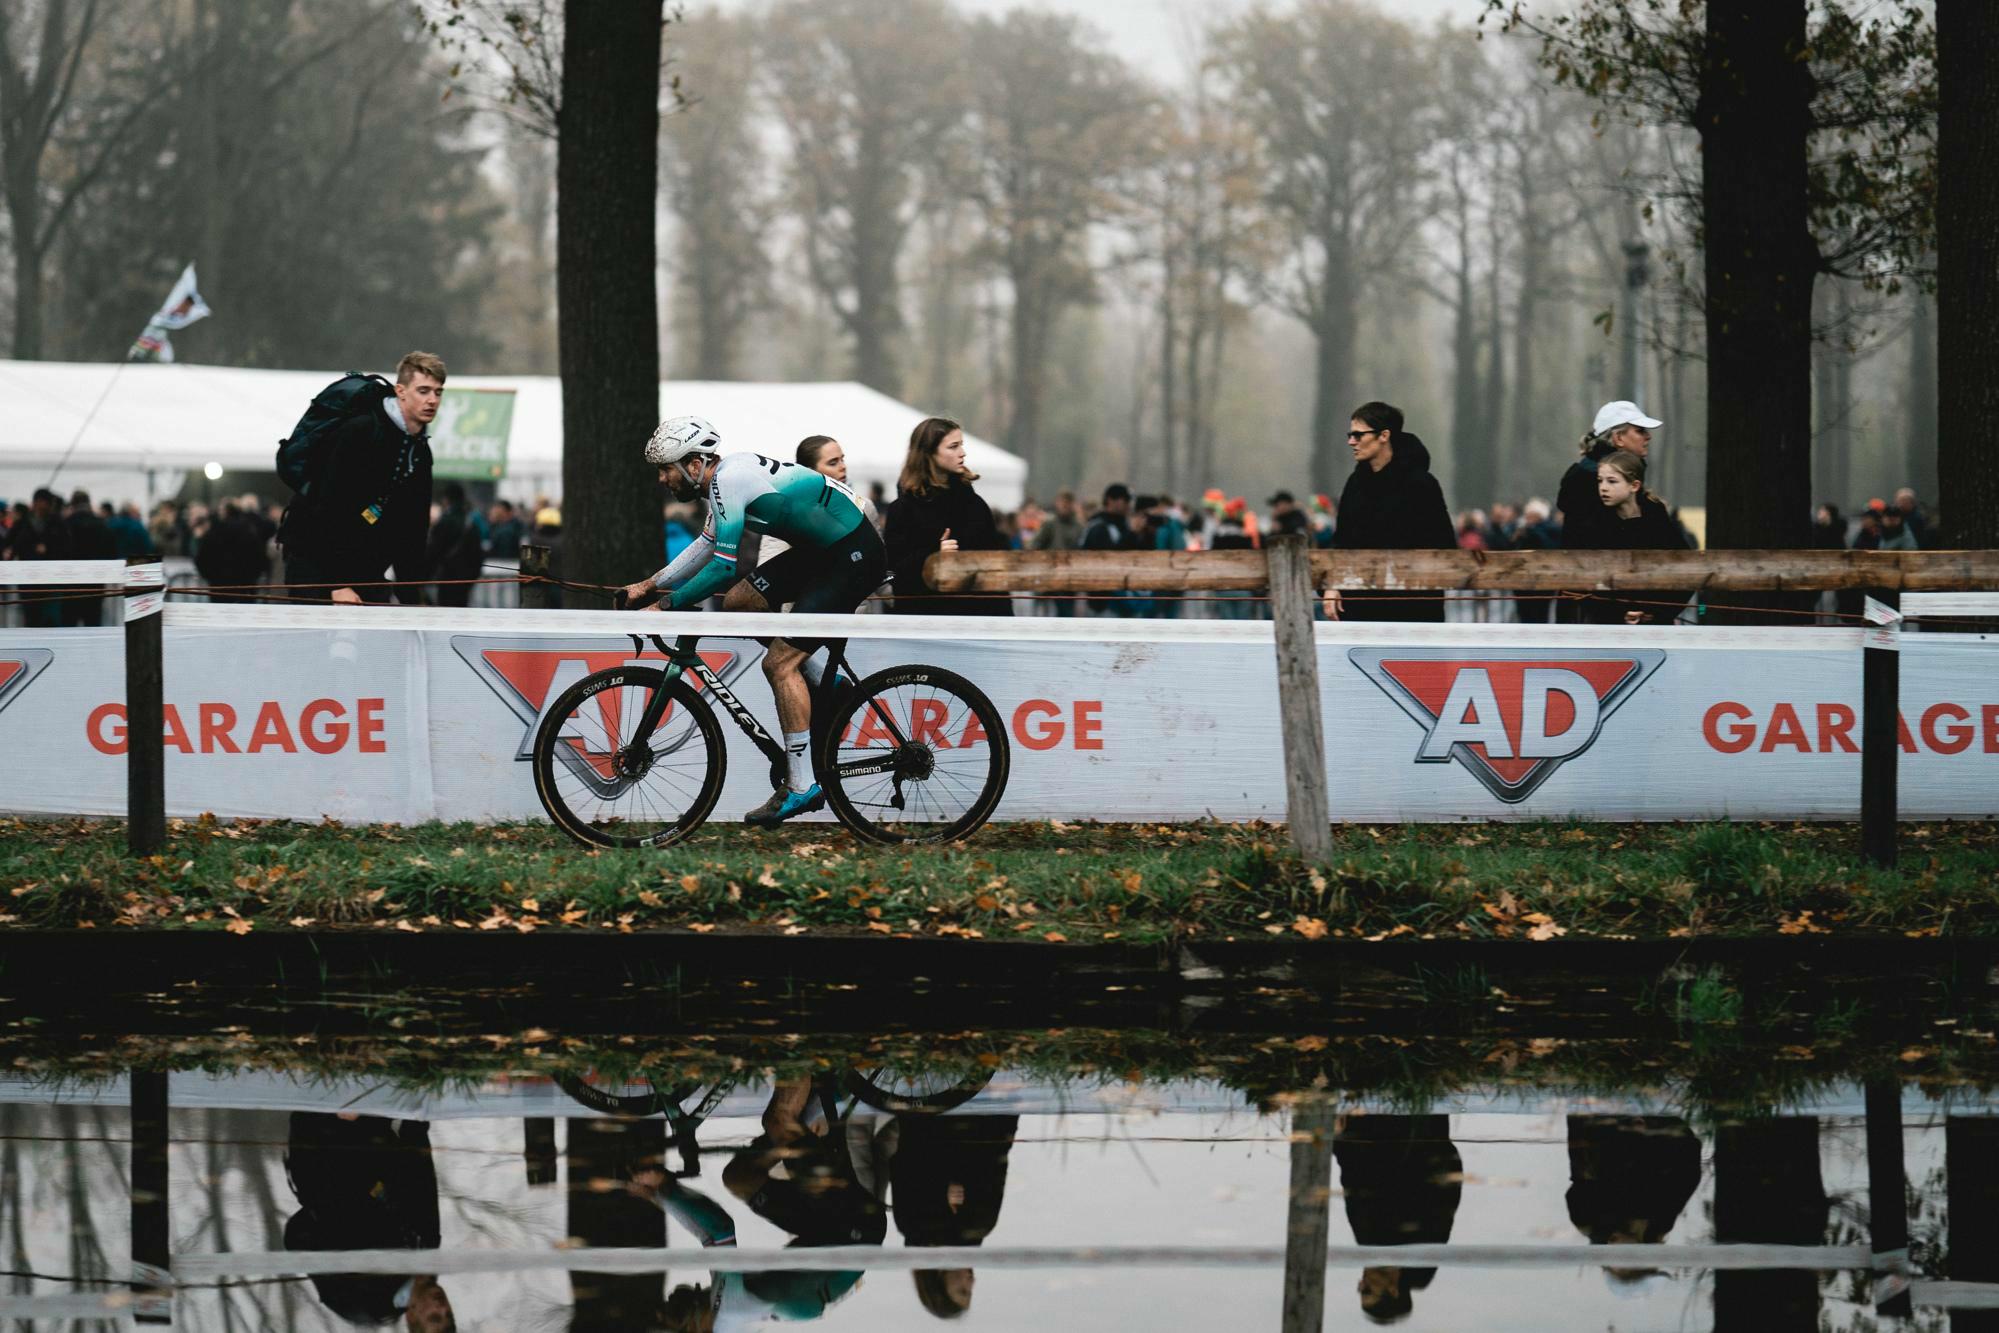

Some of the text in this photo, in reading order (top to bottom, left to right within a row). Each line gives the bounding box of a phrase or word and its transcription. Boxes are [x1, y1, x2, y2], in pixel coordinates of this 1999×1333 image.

[711, 473, 727, 521] RIDLEY
[86, 698, 386, 755] GARAGE
[694, 664, 772, 741] RIDLEY
[838, 698, 1105, 751] ARGE
[1421, 668, 1600, 758] AD
[840, 765, 881, 777] SHIMANO
